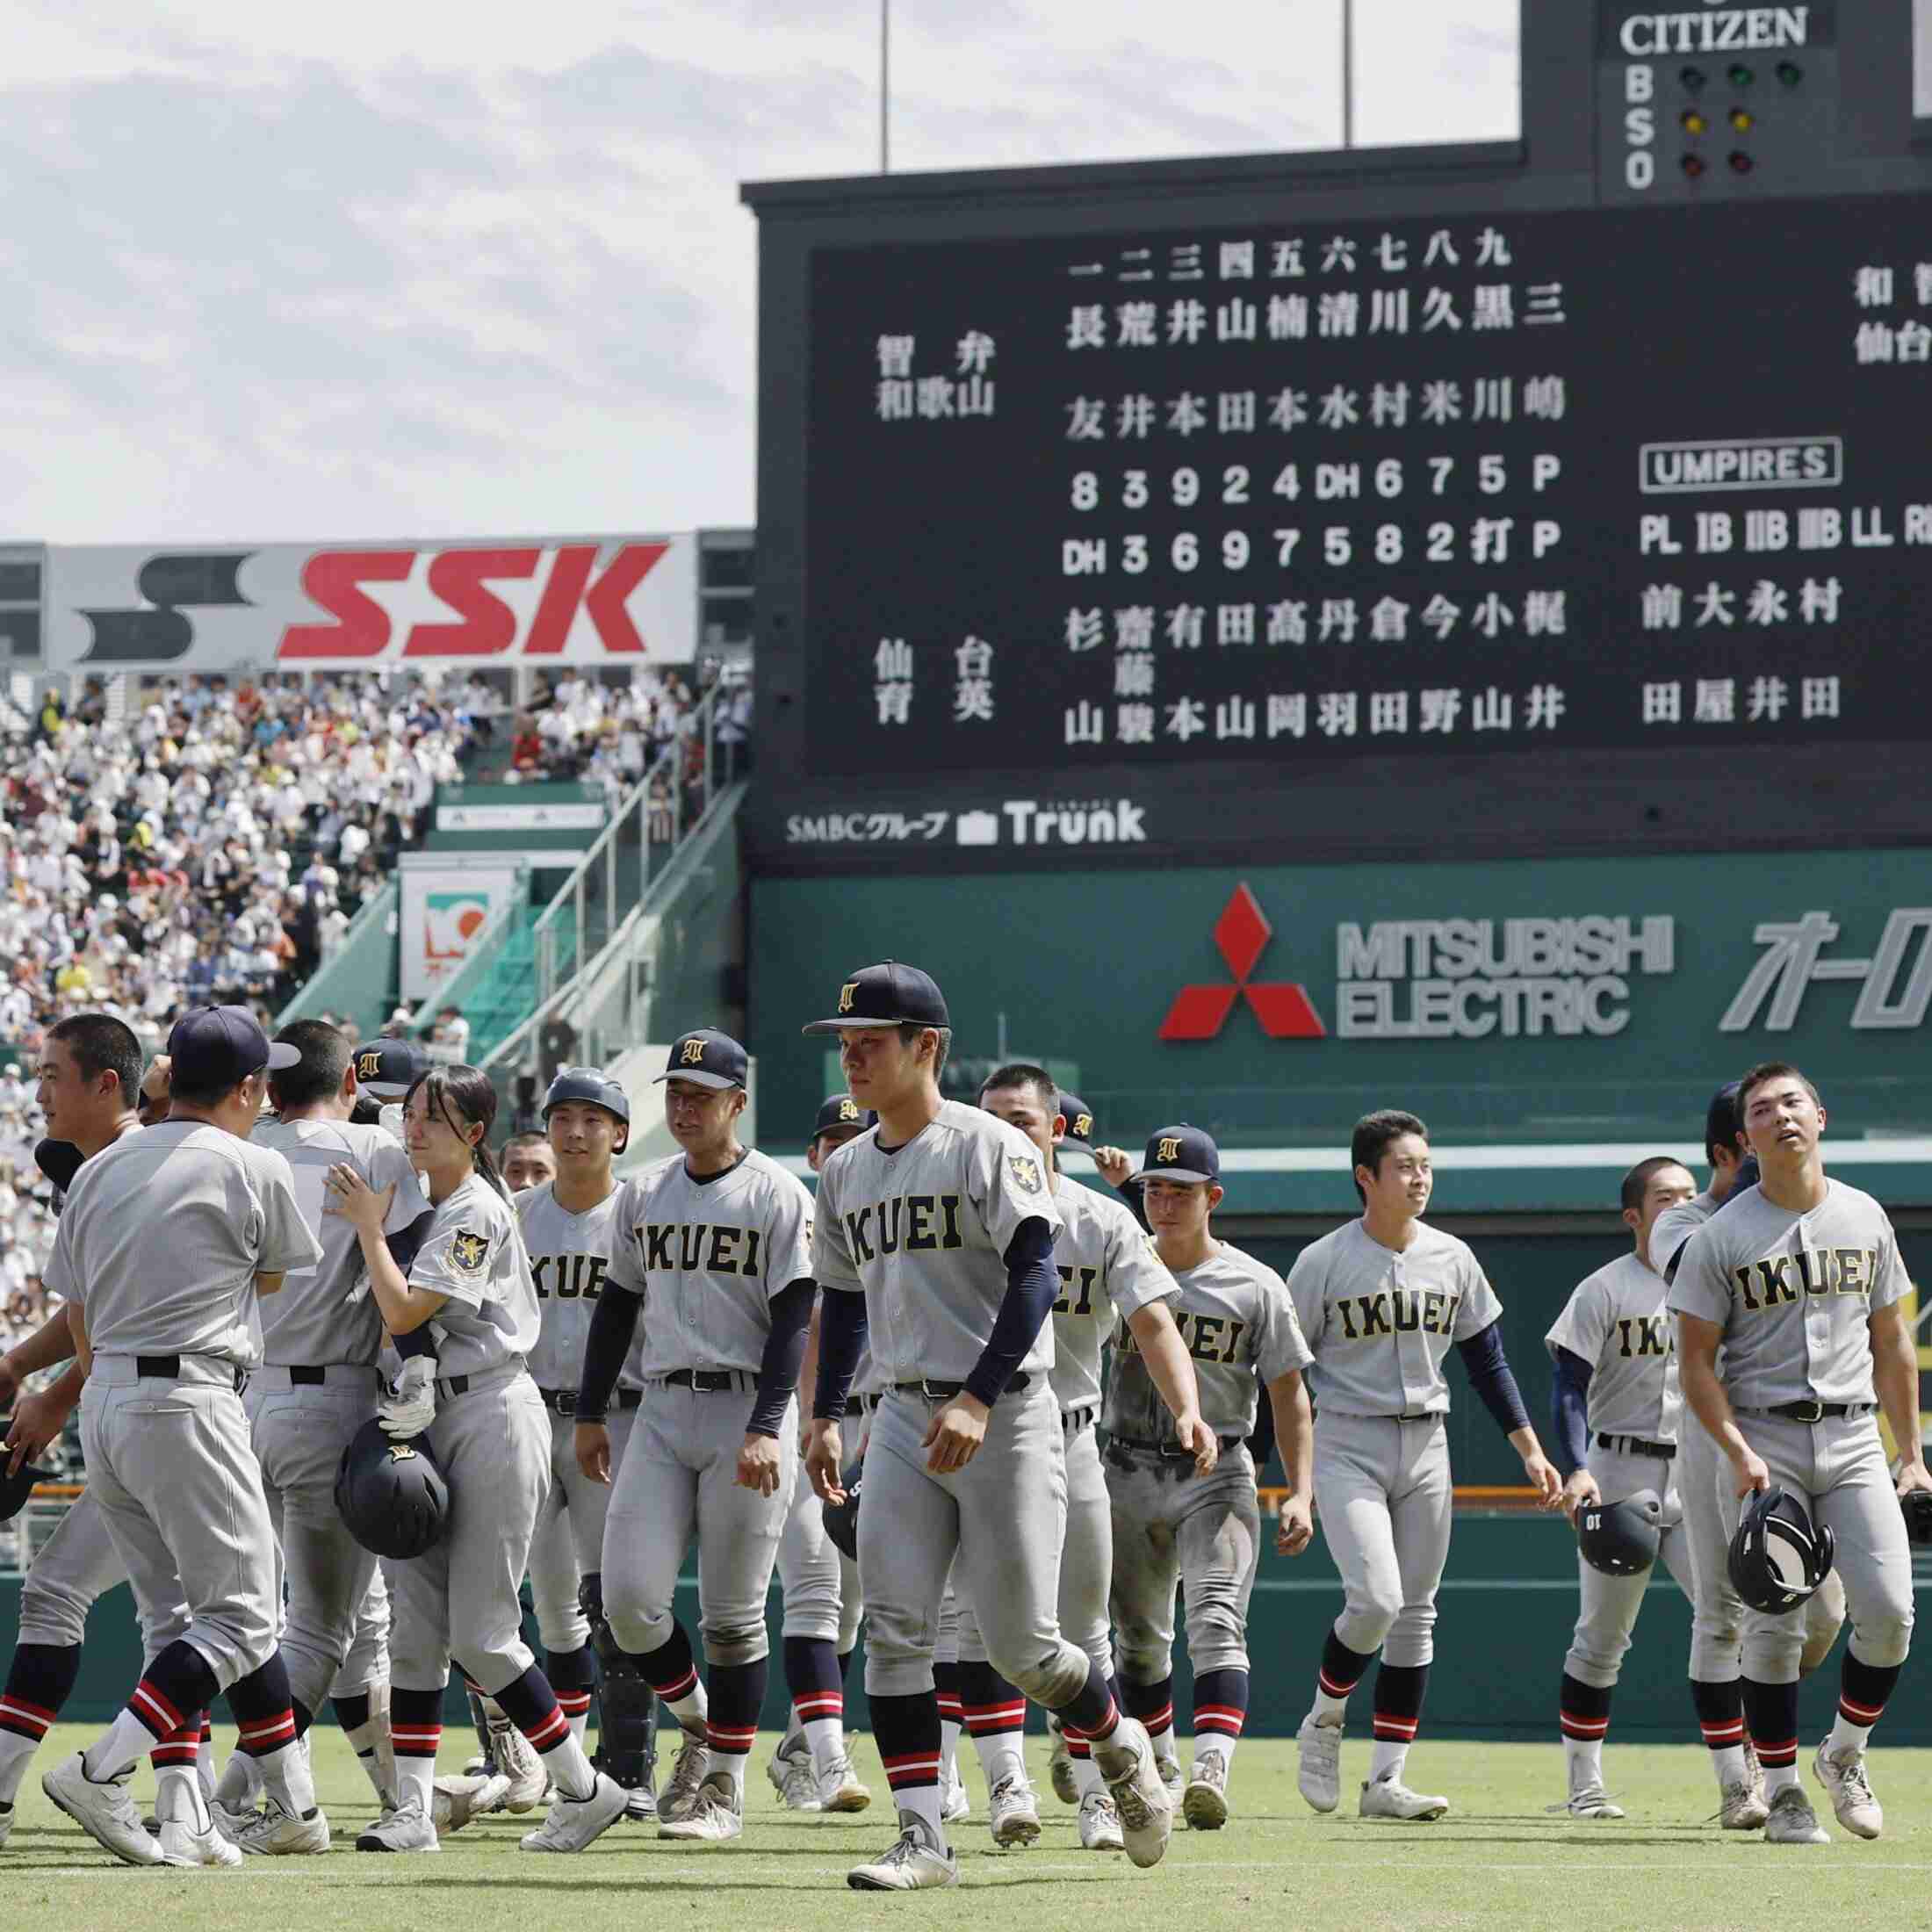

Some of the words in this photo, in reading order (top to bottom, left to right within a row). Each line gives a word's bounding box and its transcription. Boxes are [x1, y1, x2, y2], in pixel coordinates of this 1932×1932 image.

[1619, 6, 1808, 55] CITIZEN
[1625, 64, 1654, 103] B
[1625, 108, 1654, 146] S
[875, 373, 995, 422] 和歌山
[1071, 472, 1099, 511] 8
[1121, 470, 1149, 508] 3
[1171, 467, 1200, 507] 9
[1222, 465, 1251, 504] 2
[1272, 464, 1301, 501] 4
[1316, 463, 1360, 501] DH
[1374, 458, 1403, 498] 6
[1428, 456, 1454, 494] 7
[1478, 454, 1506, 494] 5
[1532, 454, 1561, 493] P
[1654, 446, 1827, 484] UMPIRES
[1063, 538, 1107, 575] DH
[1121, 535, 1150, 574] 3
[1171, 532, 1200, 572] 6
[1222, 530, 1251, 570] 9
[1272, 529, 1301, 567] 7
[1324, 526, 1352, 566] 5
[1374, 523, 1404, 564] 8
[1426, 522, 1454, 562] 2
[1470, 517, 1515, 565] 打
[1532, 520, 1562, 559] P
[1640, 515, 1683, 555] PL
[1851, 506, 1895, 547] LL
[277, 541, 671, 659] SSK
[787, 811, 949, 843] SMBCグループ
[1003, 798, 1146, 845] Trunk
[1337, 914, 1675, 979] MITSUBISHI
[1718, 907, 1932, 1032] オーロ
[1336, 975, 1631, 1039] ELECTRIC
[839, 1194, 964, 1268] KUEI
[526, 1251, 609, 1300] KUE
[1734, 1247, 1878, 1312] IKUEI
[1335, 1287, 1462, 1341] IKUEI
